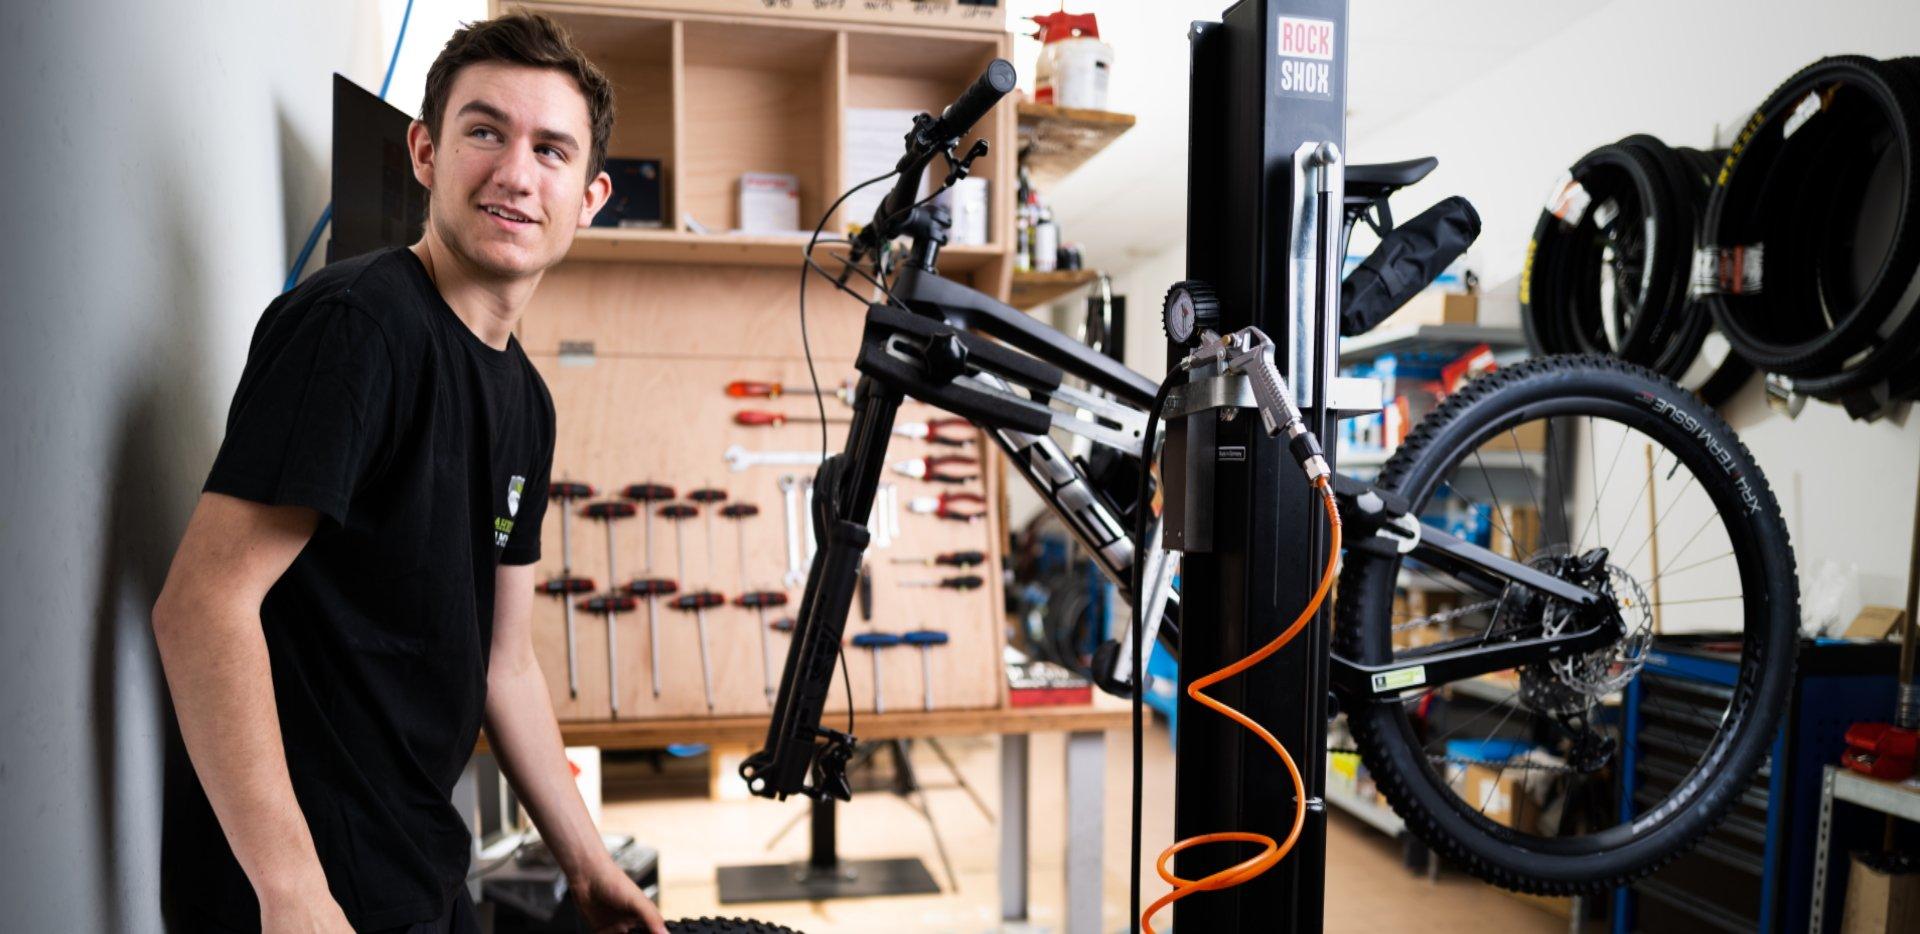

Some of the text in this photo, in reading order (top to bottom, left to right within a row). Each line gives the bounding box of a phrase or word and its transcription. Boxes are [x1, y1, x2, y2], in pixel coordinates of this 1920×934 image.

[1283, 22, 1330, 55] ROCK
[1281, 60, 1329, 94] SHOX
[1652, 397, 1762, 514] XR4 TEAM ISSUE
